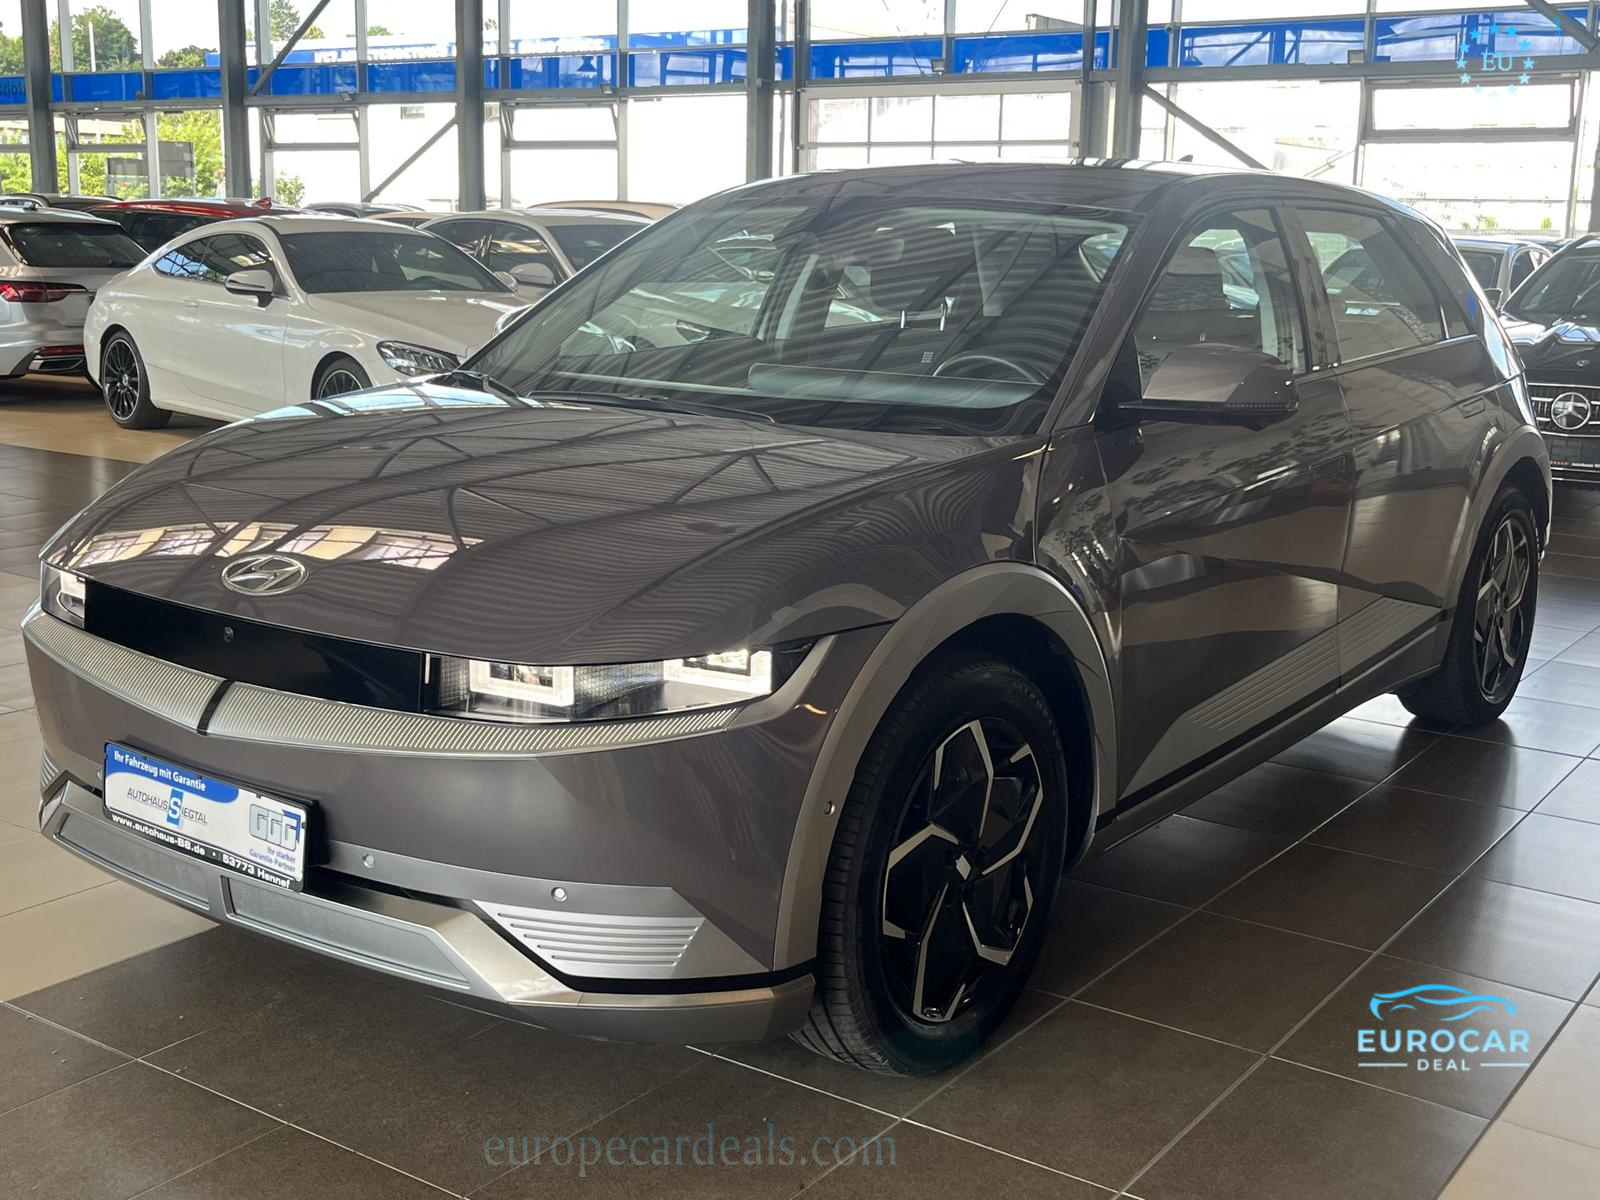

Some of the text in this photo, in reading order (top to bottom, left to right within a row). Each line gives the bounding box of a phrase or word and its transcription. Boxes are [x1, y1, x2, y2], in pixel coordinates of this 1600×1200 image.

[114, 750, 206, 792] Ihr Fahrzeug mit Garantie
[127, 787, 169, 810] AUTOHAUS
[276, 850, 296, 863] starker
[222, 854, 255, 874] 53773
[257, 868, 291, 889] Hennef
